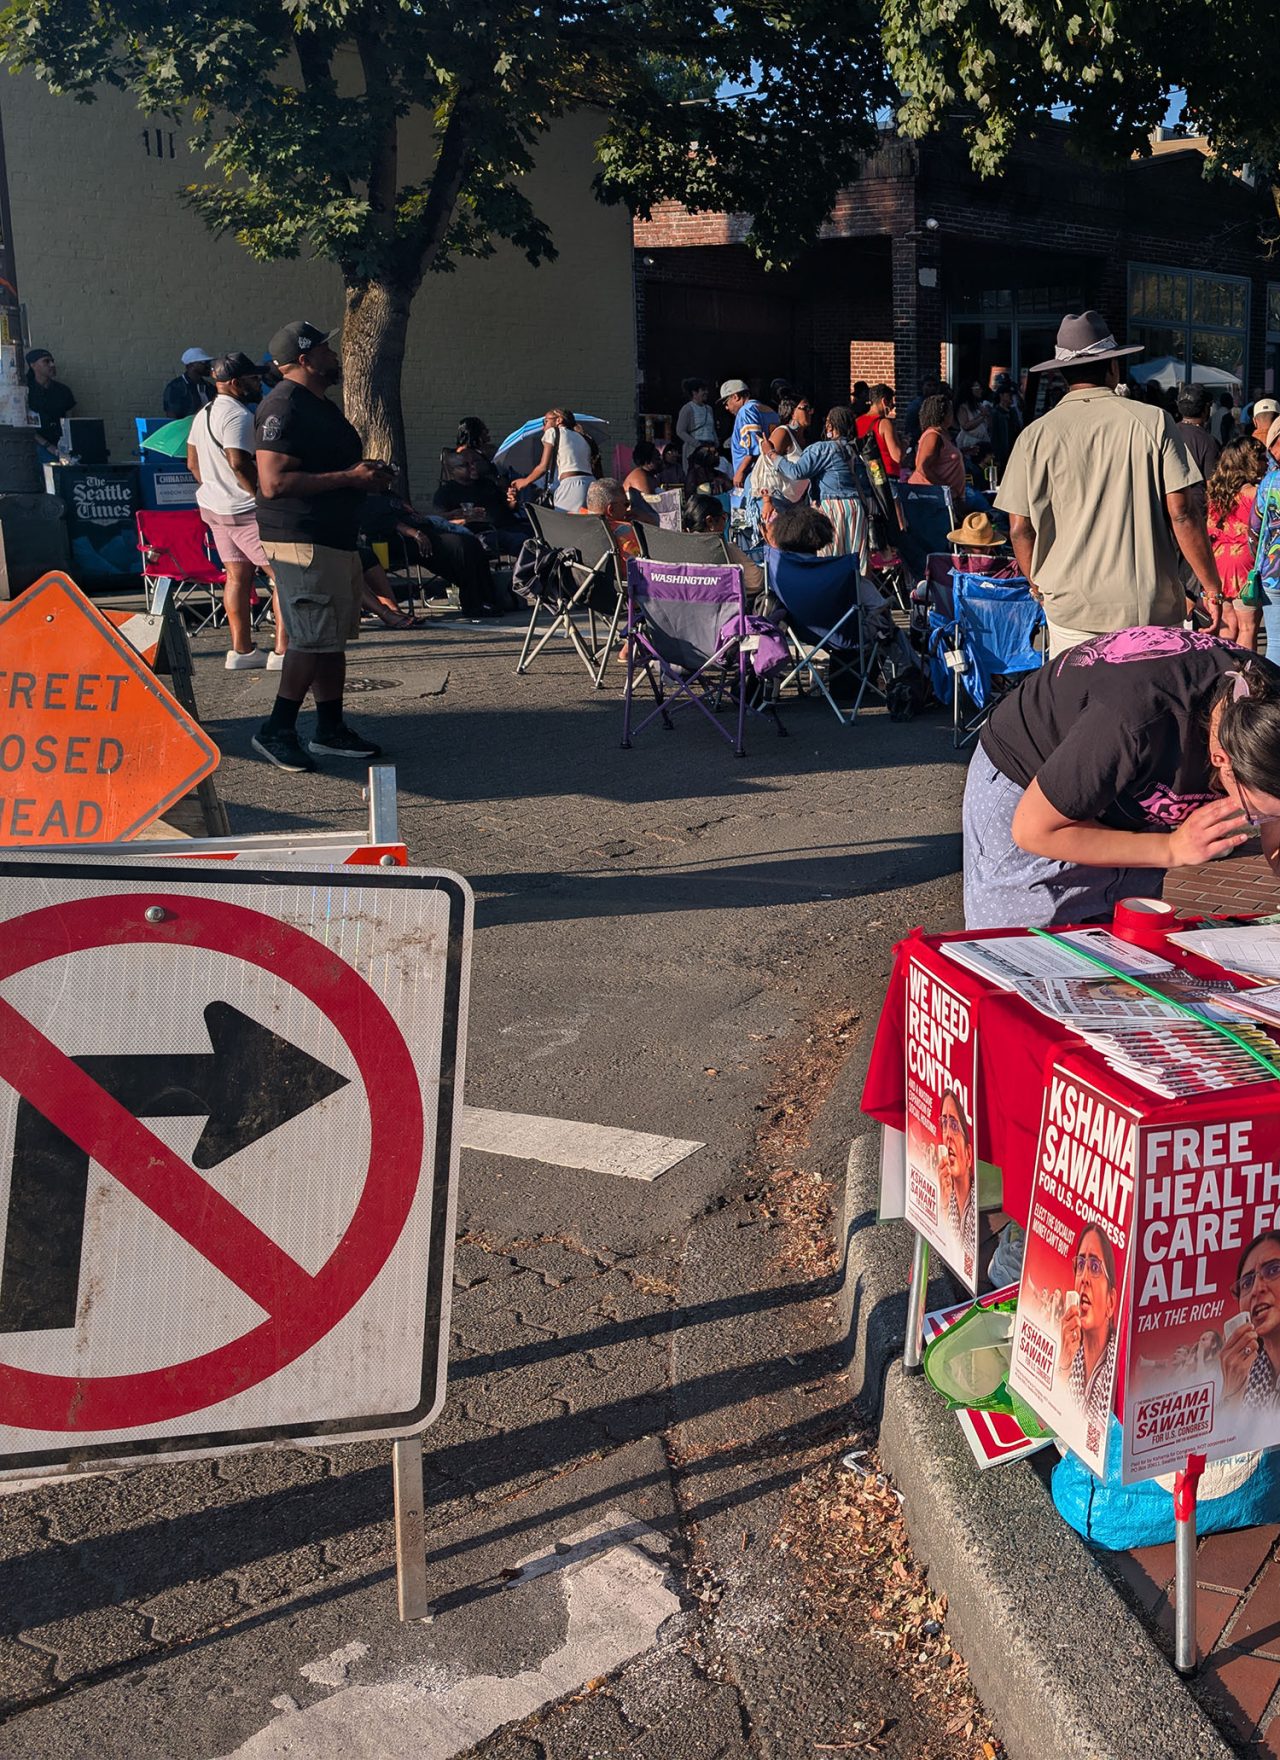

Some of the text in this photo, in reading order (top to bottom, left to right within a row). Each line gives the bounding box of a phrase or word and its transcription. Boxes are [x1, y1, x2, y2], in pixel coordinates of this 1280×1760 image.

[73, 484, 132, 501] Seattle
[86, 476, 106, 487] The
[76, 501, 132, 519] Times
[650, 572, 718, 586] WASHINGTON
[0, 671, 130, 712] REET
[0, 734, 124, 774] OSED
[0, 798, 104, 838] EAD
[909, 963, 970, 1043] WE NEED
[909, 1000, 954, 1069] RENT
[908, 1038, 972, 1126] CONTROL
[1048, 1076, 1136, 1177] KSHAMA
[1146, 1120, 1252, 1175] FREE
[910, 1168, 936, 1197] KSHAMA
[1042, 1124, 1134, 1227] SAWANT
[910, 1182, 936, 1212] SAWANT
[1038, 1170, 1125, 1250] FOR U.S. CONGRESS
[1142, 1210, 1244, 1263] CARE
[1139, 1256, 1218, 1307] ALL
[1138, 1299, 1224, 1333] TAX THE RICH!
[1020, 1339, 1053, 1374] SAWANT
[1021, 1321, 1054, 1361] KSHAMA
[1136, 1388, 1208, 1422] KSHAMA
[1136, 1404, 1210, 1440] SAWANT
[1152, 1433, 1164, 1445] FOR
[1165, 1430, 1176, 1440] U.S.
[1178, 1420, 1209, 1438] CONGRESS
